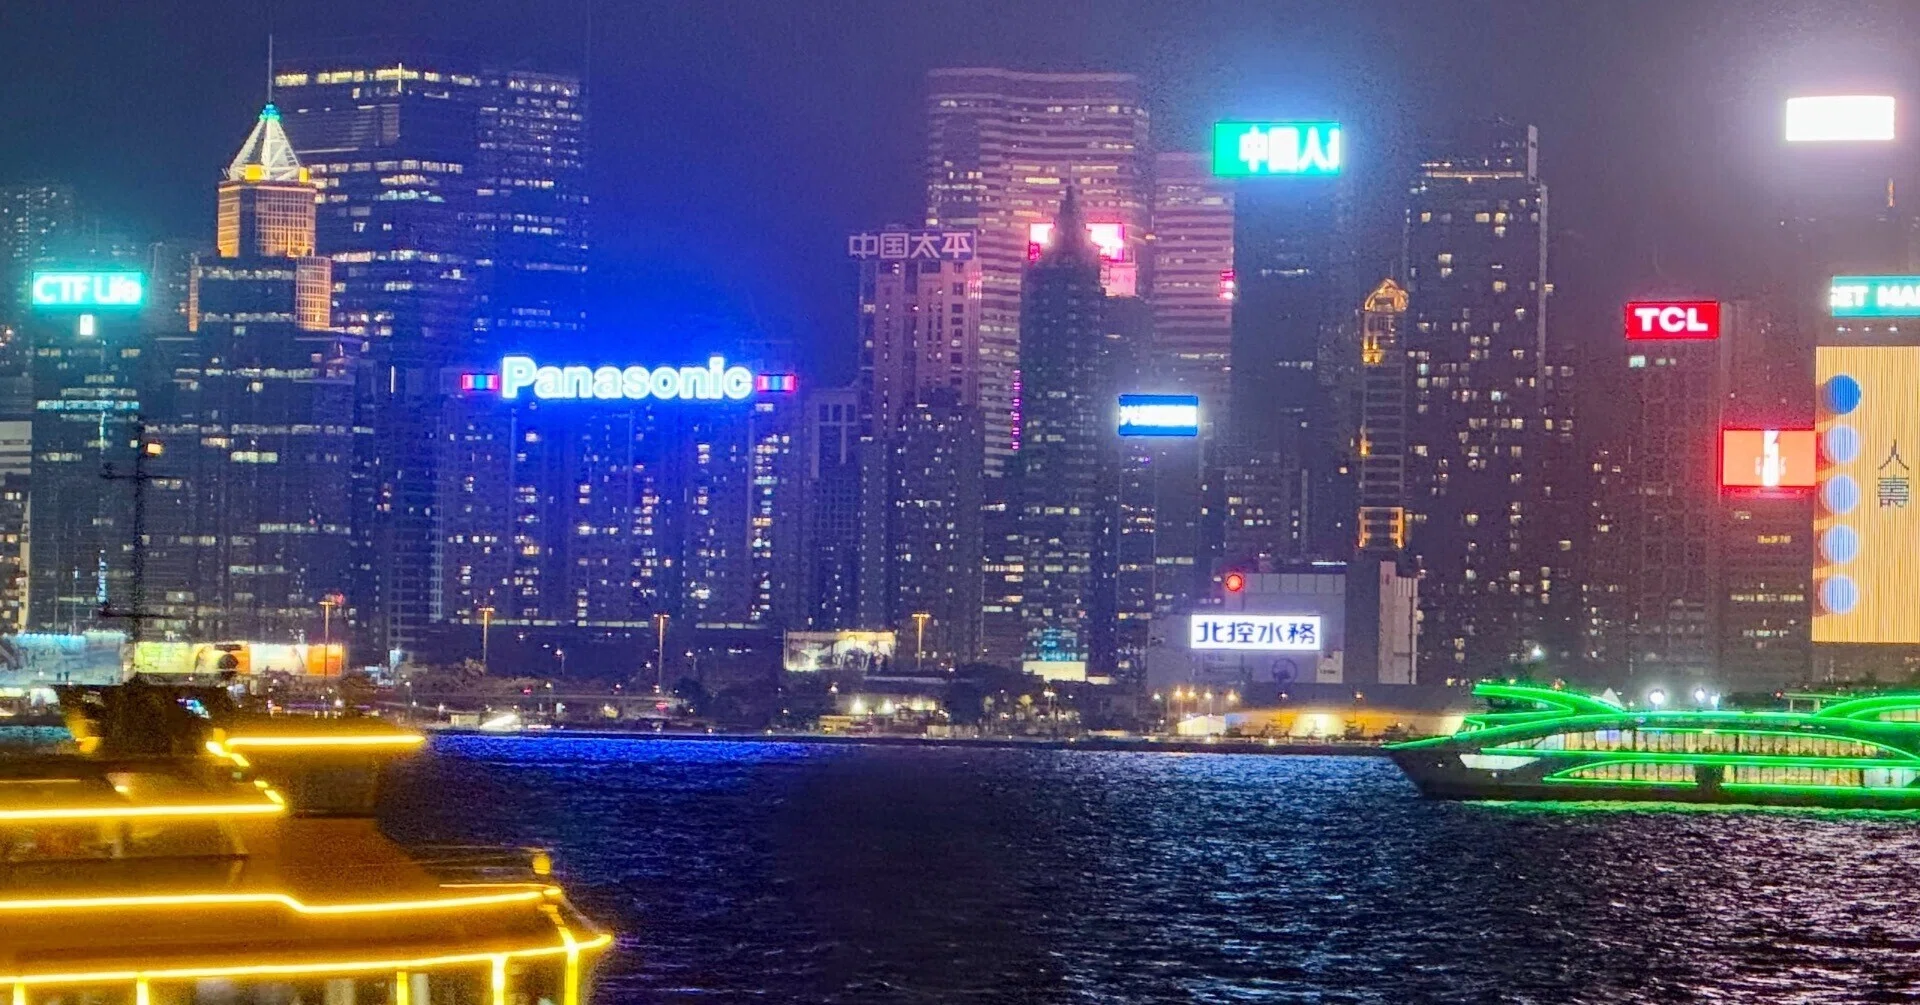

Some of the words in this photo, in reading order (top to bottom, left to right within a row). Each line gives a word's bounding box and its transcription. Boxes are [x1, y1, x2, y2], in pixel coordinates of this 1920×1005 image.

[849, 232, 971, 259] 中国太平
[34, 275, 90, 303] CTF
[1634, 306, 1709, 333] TCL
[501, 355, 753, 400] Panasonic
[1196, 621, 1316, 645] 北控水務
